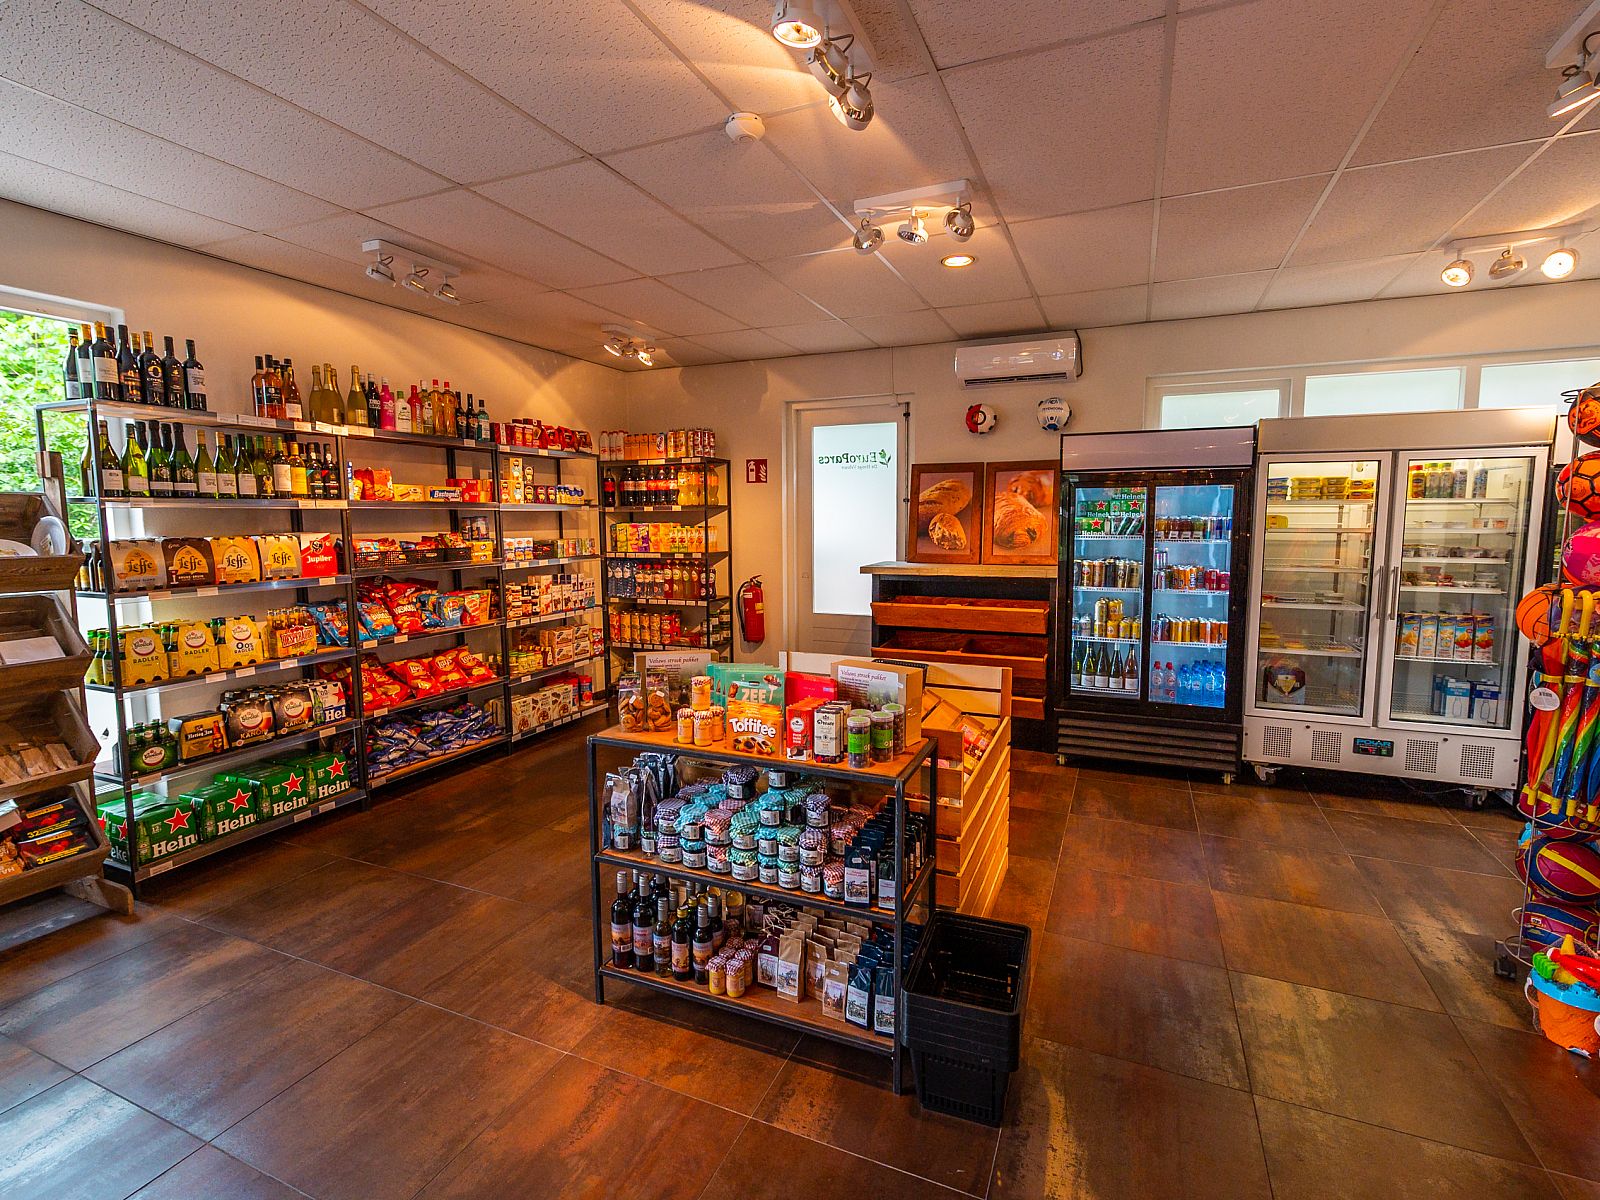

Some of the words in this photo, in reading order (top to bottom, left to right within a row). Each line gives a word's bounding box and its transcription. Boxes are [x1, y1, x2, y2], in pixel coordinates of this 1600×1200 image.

[126, 557, 153, 574] Leffe
[178, 555, 202, 571] Leffe
[225, 553, 248, 569] Leffe
[271, 551, 292, 564] Leffe
[306, 555, 332, 563] Jupiler
[133, 655, 159, 664] RADLER
[184, 648, 209, 656] RADLER
[741, 688, 767, 704] ZEE
[324, 706, 346, 722] Hei
[729, 717, 776, 738] Toffifee
[317, 780, 351, 798] Hein
[272, 795, 309, 816] Hein
[217, 813, 257, 835] Hein
[26, 830, 40, 838] 32
[152, 833, 199, 858] Hein
[36, 856, 49, 865] 32
